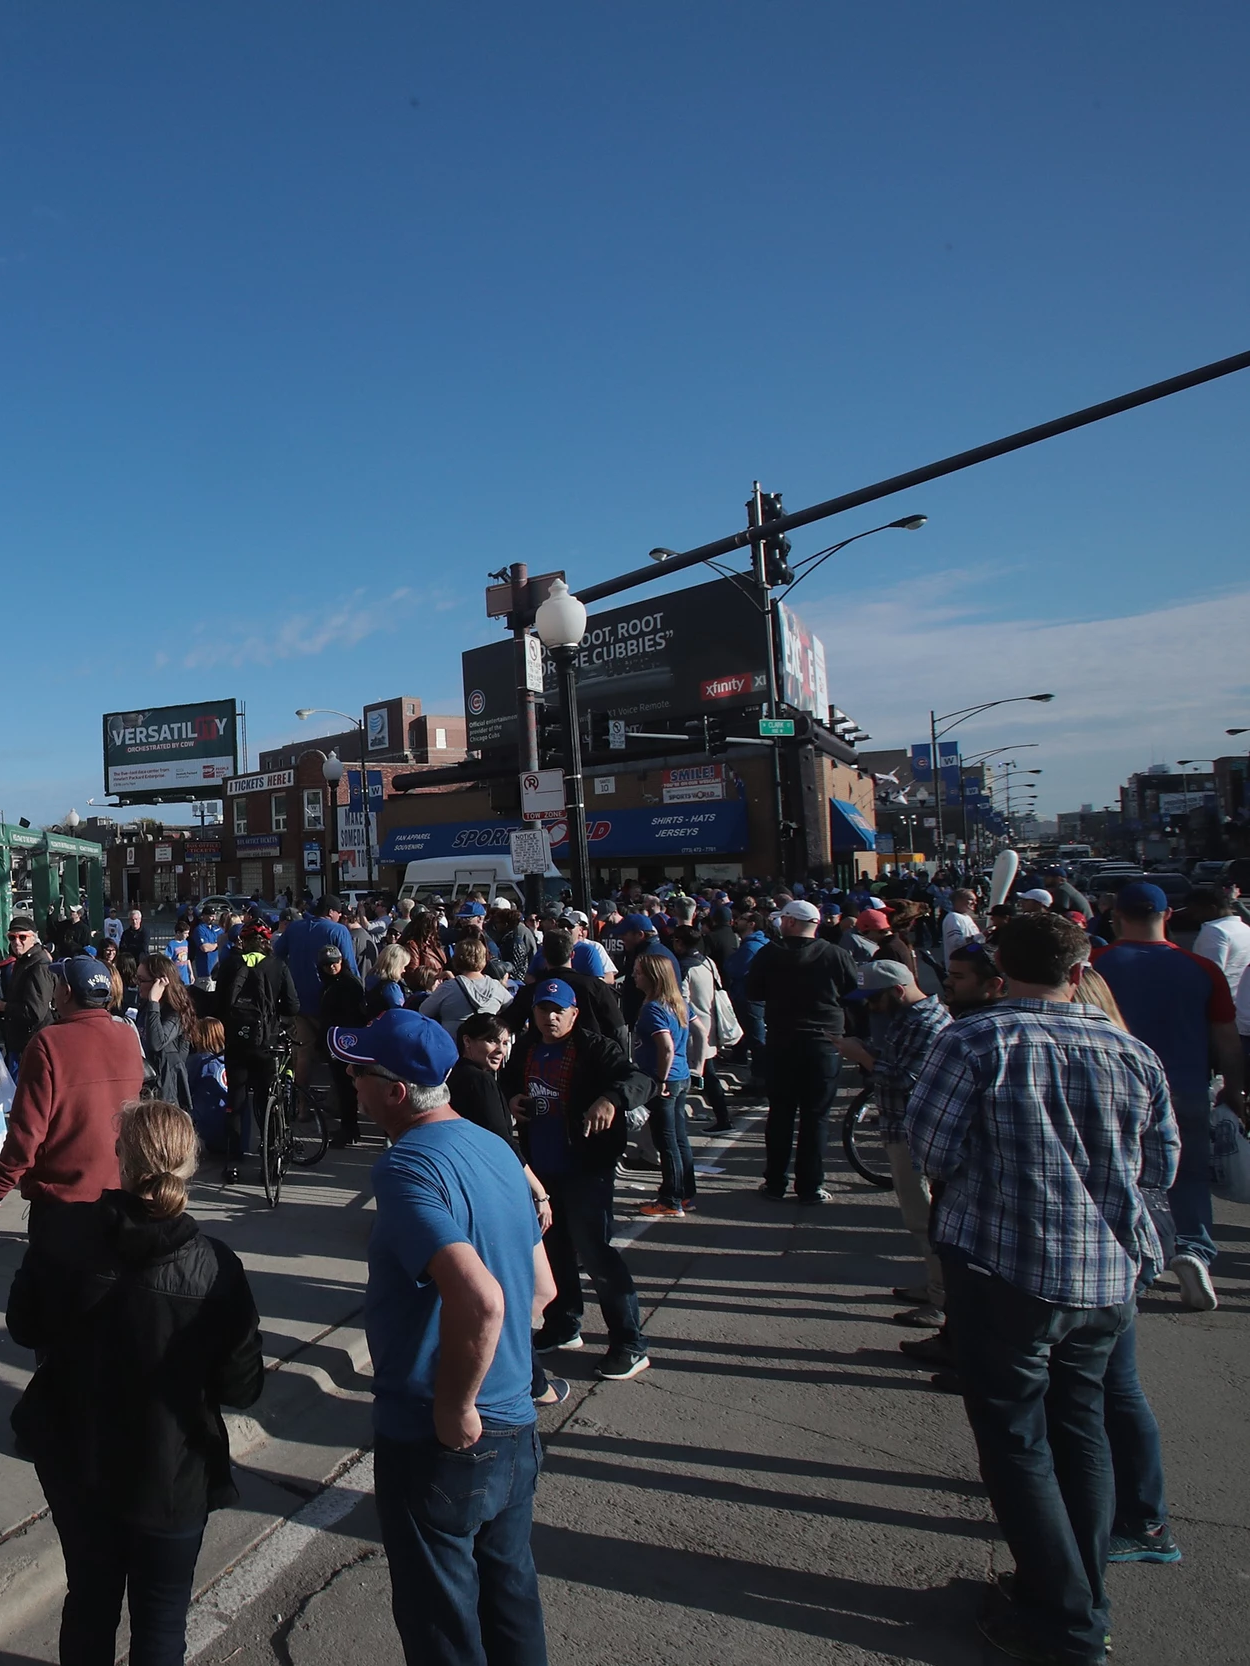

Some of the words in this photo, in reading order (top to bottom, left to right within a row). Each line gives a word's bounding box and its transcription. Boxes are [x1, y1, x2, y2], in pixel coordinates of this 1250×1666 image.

[617, 612, 664, 640] ROOT
[705, 678, 745, 697] xfinity
[618, 706, 638, 716] Voice
[469, 719, 486, 728] Official
[486, 714, 518, 726] entertainmen
[469, 727, 486, 737] provider
[469, 733, 488, 743] Chicago
[127, 742, 171, 753] ORCHESTRATED
[171, 741, 180, 749] BY
[670, 764, 715, 783] SMILE!
[233, 776, 264, 792] TICKETS
[267, 774, 287, 787] HERE
[600, 784, 609, 792] 10
[371, 786, 380, 795] W
[526, 812, 541, 820] TOW
[544, 810, 563, 819] ZONE
[651, 815, 684, 826] SHIRTS
[690, 813, 717, 823] HATS
[406, 832, 431, 841] APPAREL
[515, 833, 537, 841] NOTICE
[655, 827, 700, 838] JERSEYS
[259, 836, 279, 844] TICKETS
[393, 842, 424, 851] SOUVENIRS
[602, 938, 625, 951] UBS
